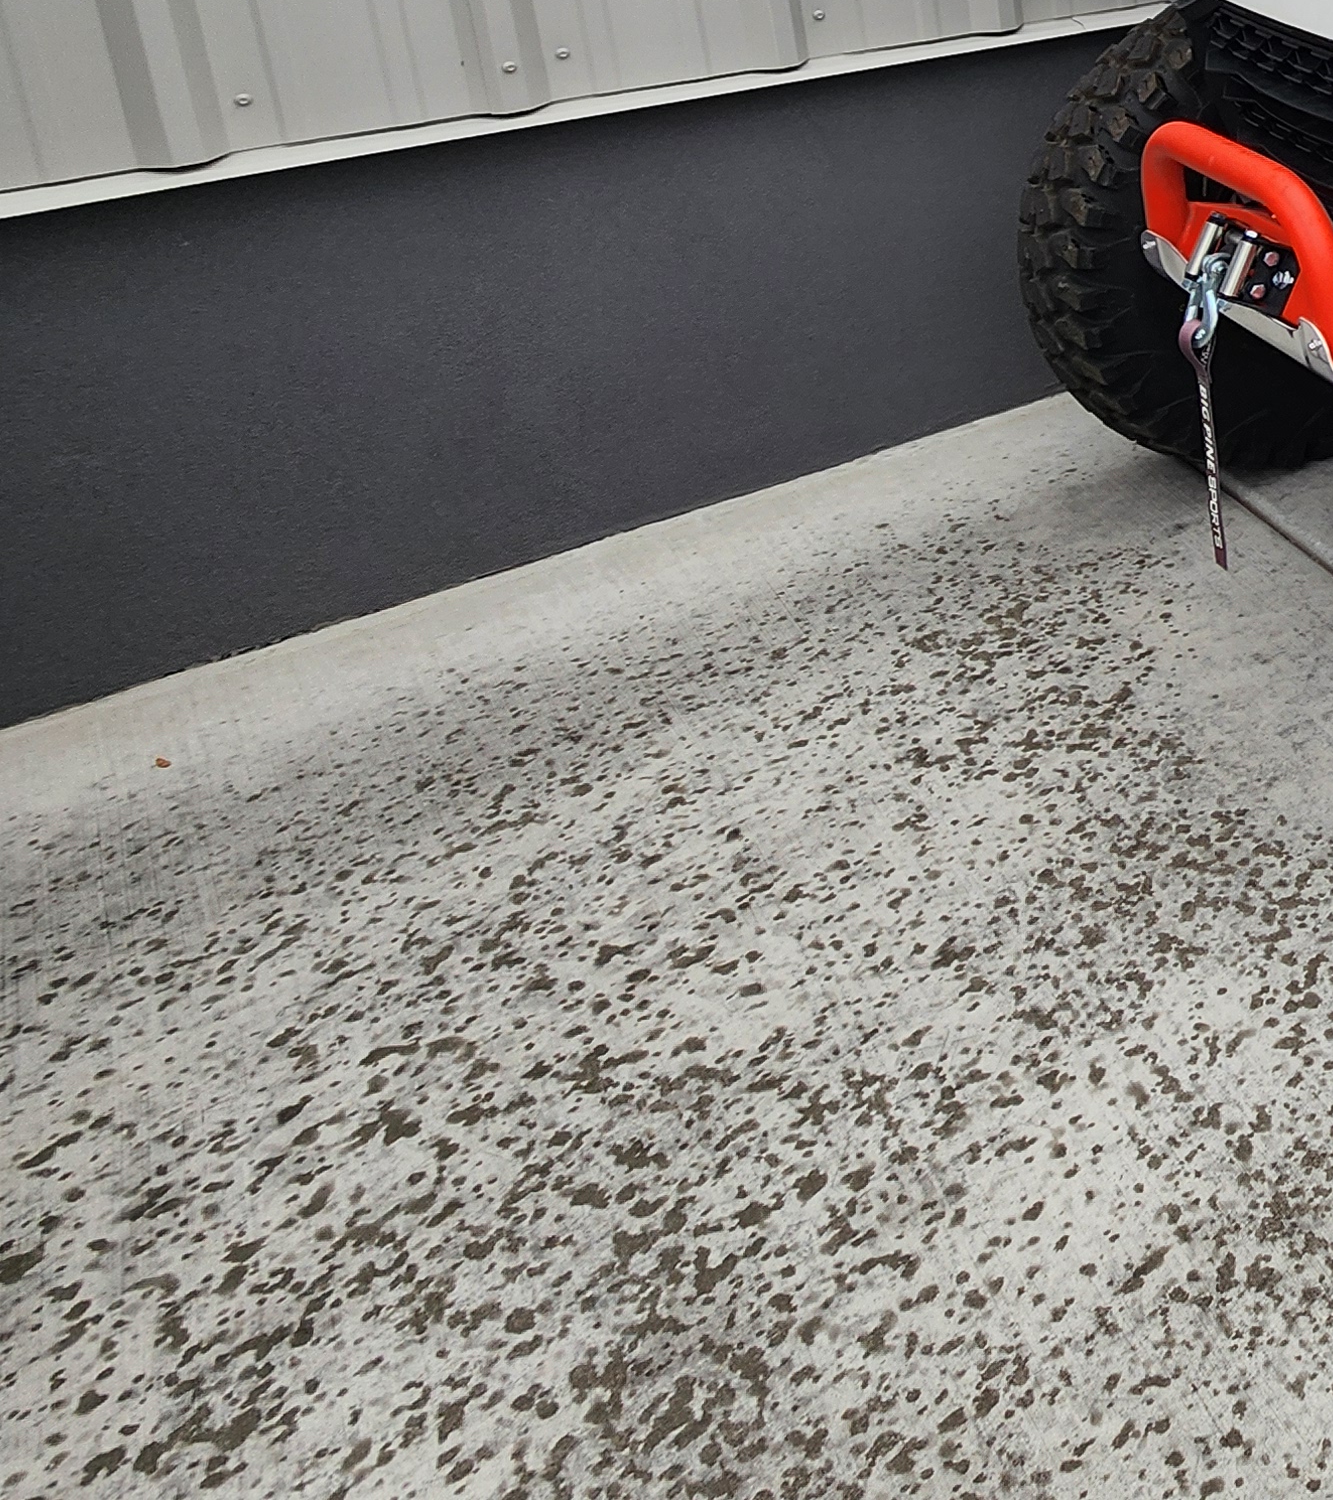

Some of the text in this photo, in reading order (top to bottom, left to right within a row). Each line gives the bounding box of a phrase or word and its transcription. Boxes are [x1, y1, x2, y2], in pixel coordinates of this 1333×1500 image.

[1199, 384, 1223, 549] BIG PINE SPORTS
